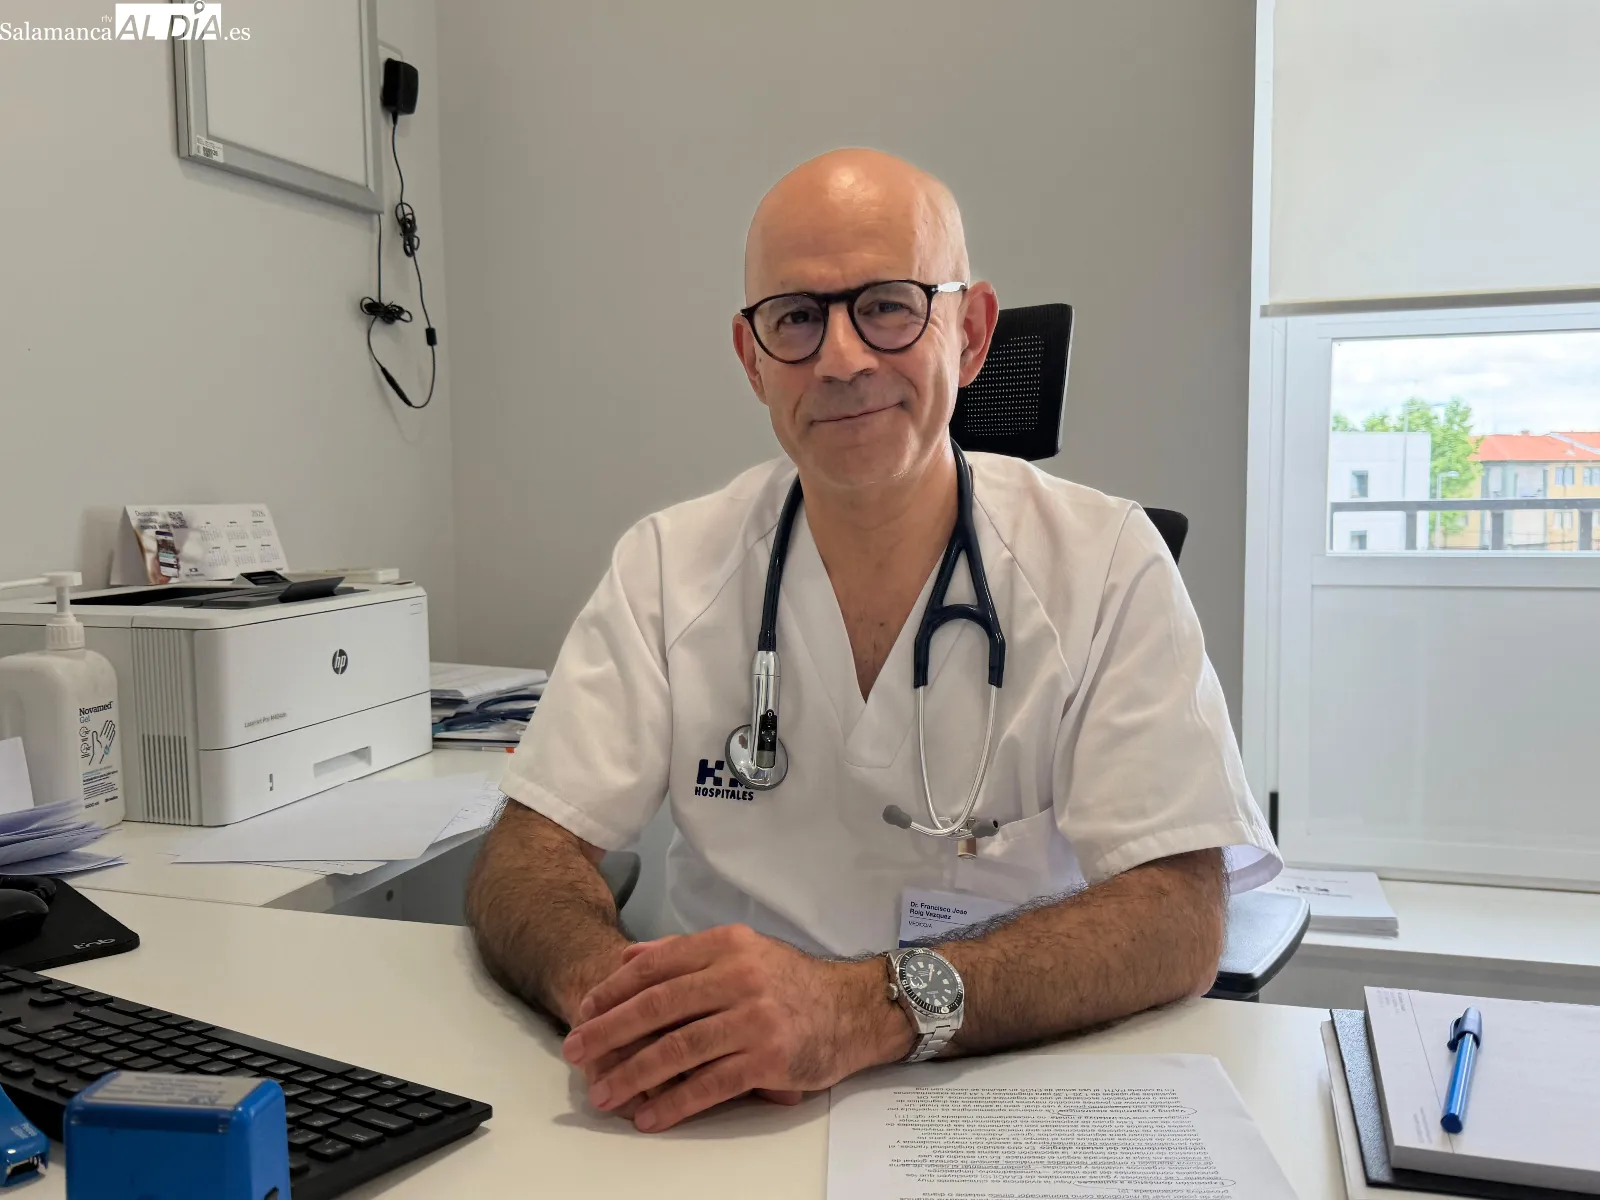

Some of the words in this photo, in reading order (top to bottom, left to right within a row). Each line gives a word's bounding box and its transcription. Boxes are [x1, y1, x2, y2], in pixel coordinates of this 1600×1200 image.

[333, 648, 347, 674] hp
[79, 702, 112, 716] Novamed
[80, 715, 91, 724] Gel
[694, 786, 754, 800] HOSPITALES
[909, 908, 924, 916] Roig
[920, 902, 951, 913] Francisco
